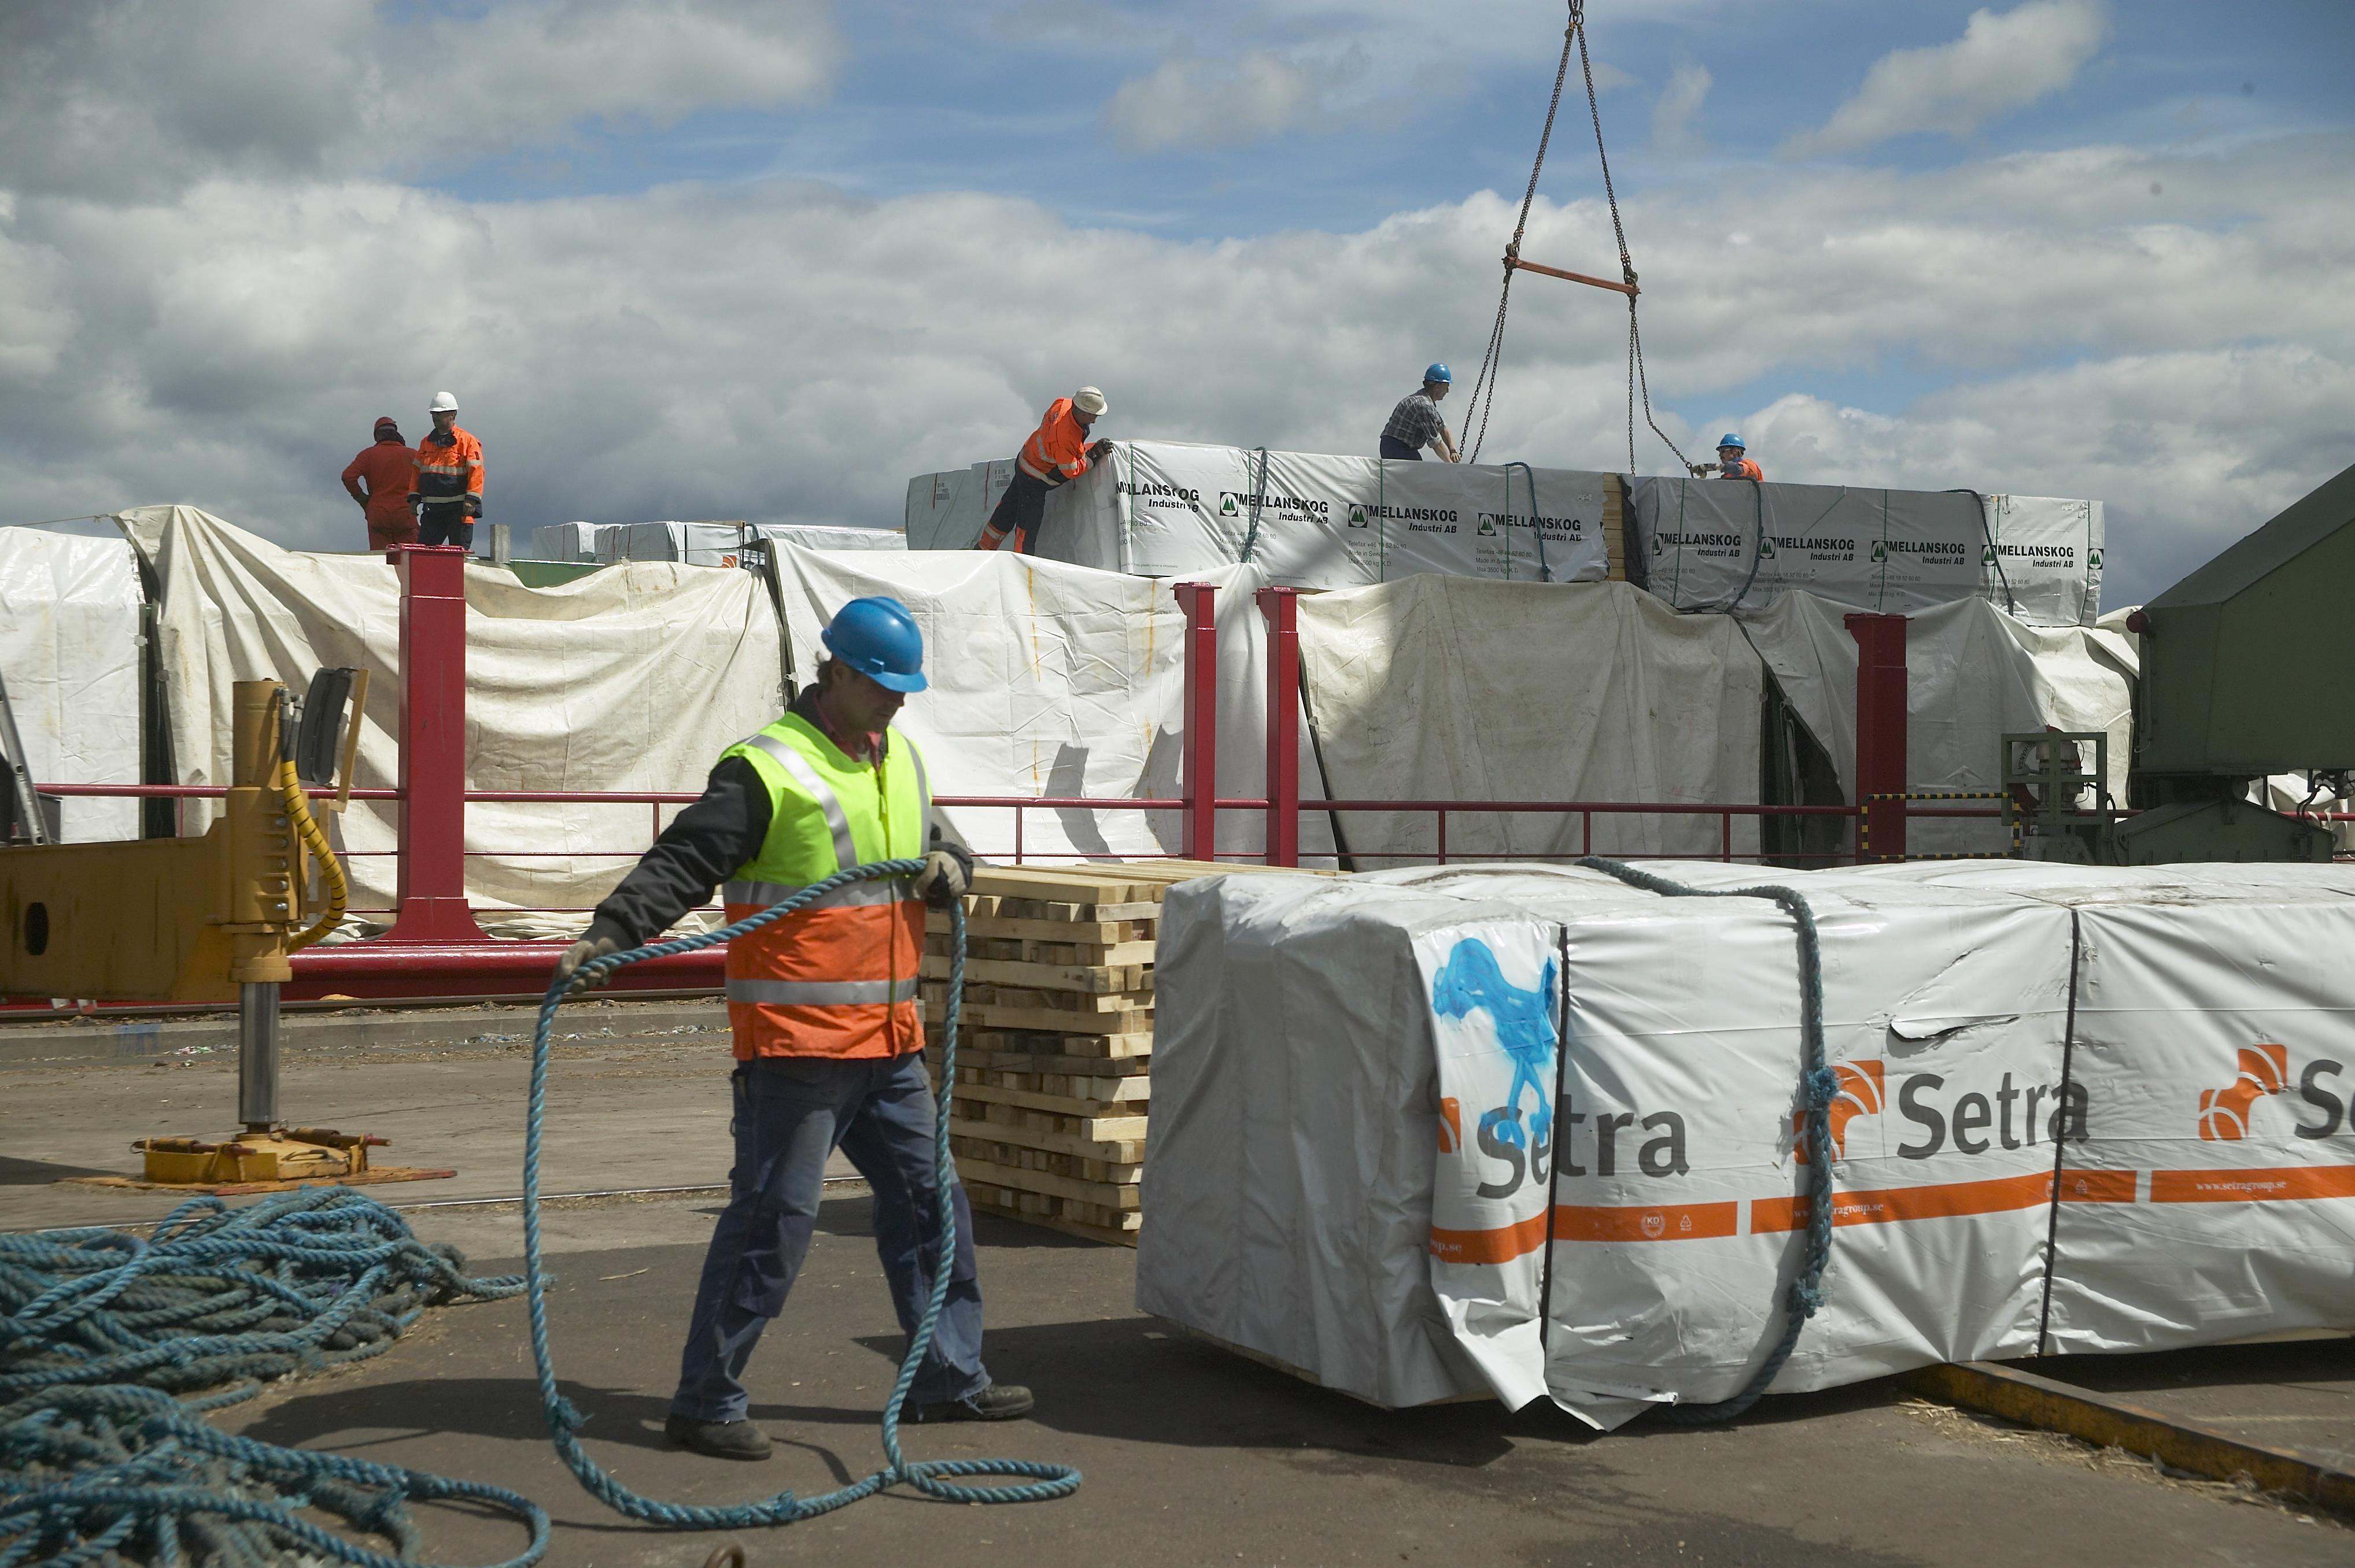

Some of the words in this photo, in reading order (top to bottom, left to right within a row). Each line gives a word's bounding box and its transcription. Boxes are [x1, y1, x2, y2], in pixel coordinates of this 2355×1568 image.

[1116, 482, 1199, 501] MLLANSKOG
[1149, 499, 1186, 509] Industri
[1279, 512, 1314, 523] Industri
[1369, 505, 1457, 522] MELLANSKOG
[1409, 523, 1442, 532] Industri
[1445, 526, 1457, 534] AB
[1496, 514, 1581, 531] MELLANSKOG
[1664, 534, 1741, 546] MELLANSKOG
[1777, 537, 1855, 550] MELLANSKOG
[1697, 548, 1726, 557] Industri
[1889, 541, 1965, 554] MELLANSKOG
[1998, 545, 2074, 557] MELLANSKOG
[1810, 553, 1840, 561] Industri
[1922, 556, 1952, 565] Industri
[2032, 560, 2061, 568] Industri
[2018, 746, 2028, 770] HANSA
[1897, 1072, 2090, 1160] Setra
[1477, 1094, 1690, 1200] Setra
[2195, 1181, 2286, 1193] www.setragroup.se
[1647, 1216, 1660, 1225] KD
